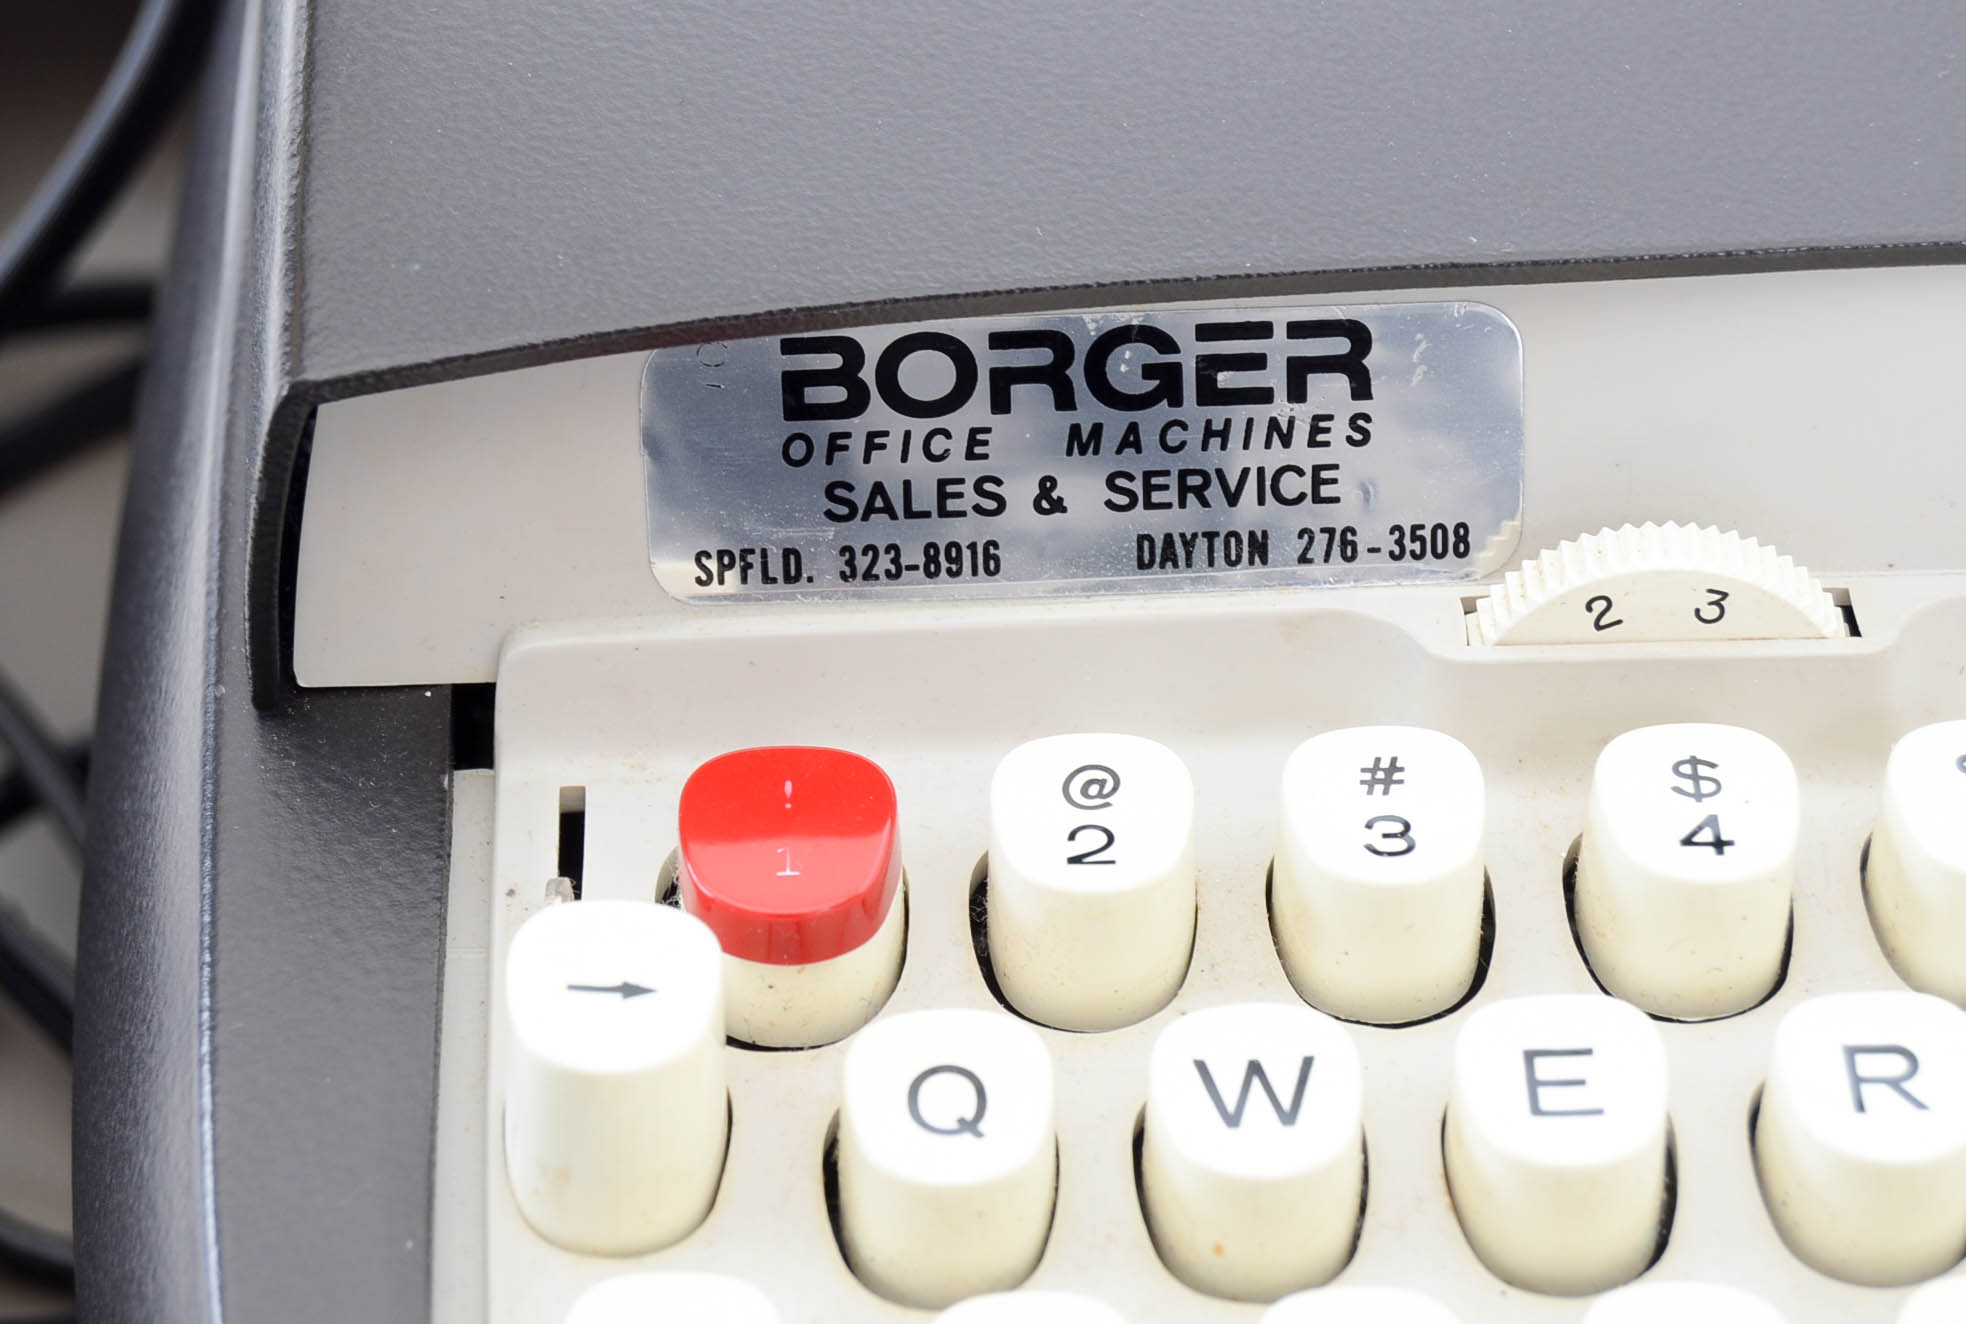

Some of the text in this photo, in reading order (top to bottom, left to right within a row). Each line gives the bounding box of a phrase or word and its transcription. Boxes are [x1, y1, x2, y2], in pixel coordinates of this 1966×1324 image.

[780, 318, 1375, 423] BORGER
[781, 412, 1373, 469] OFFICE MACHINES
[822, 463, 1341, 524] SALES & SERVICE
[694, 538, 1001, 588] SPFLD. 323-8916
[1136, 521, 1471, 571] DAYTON 276-3508
[1585, 588, 1730, 632] 2 3
[784, 780, 793, 809] !
[1062, 764, 1121, 809] @
[1360, 755, 1406, 796] #
[1671, 755, 1722, 803] $
[1067, 824, 1116, 865] 2
[1365, 814, 1416, 858] 3
[1680, 814, 1735, 856] 4
[775, 847, 801, 877] 1
[908, 1063, 989, 1139] Q
[1194, 1055, 1316, 1129] W
[1523, 1047, 1606, 1117] E
[1843, 1044, 1929, 1114] R
